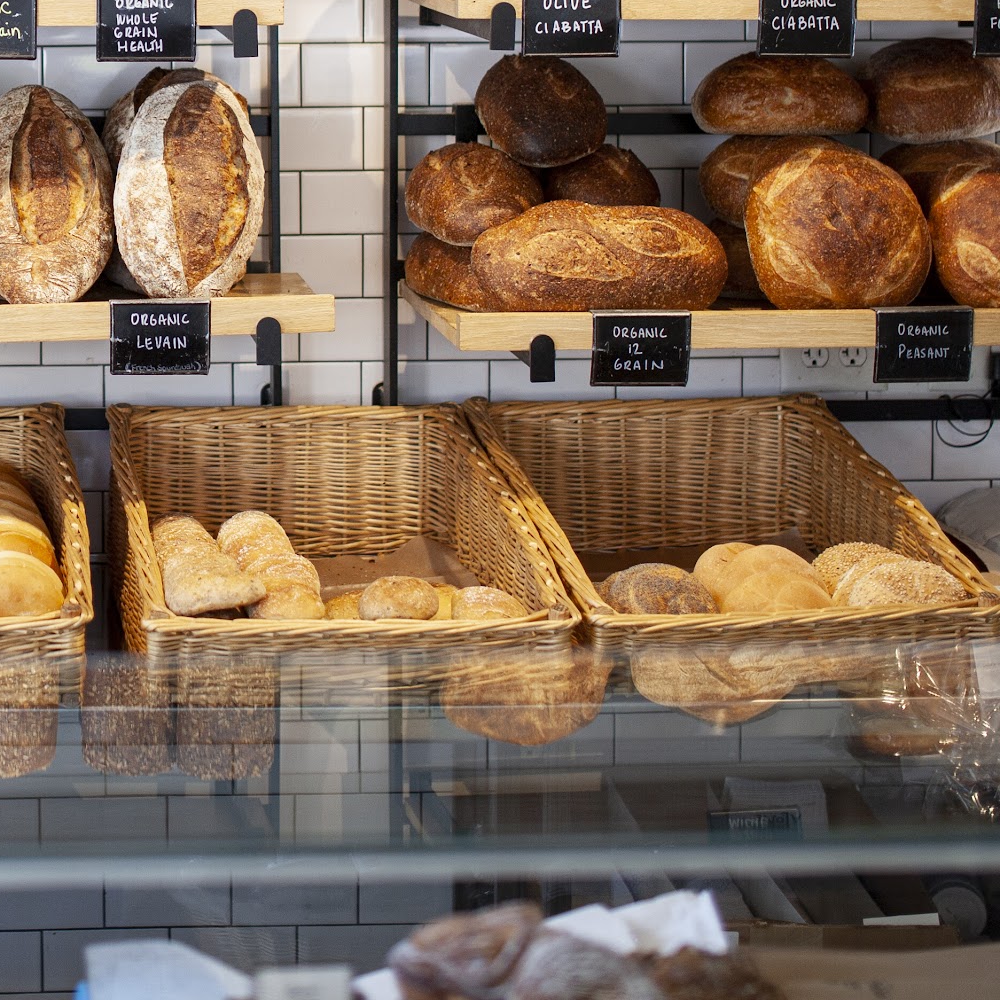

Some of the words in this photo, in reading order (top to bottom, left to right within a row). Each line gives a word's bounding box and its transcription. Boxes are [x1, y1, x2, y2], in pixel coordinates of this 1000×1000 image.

[116, 12, 159, 26] WHOLE
[771, 15, 840, 31] CIABATTA
[113, 26, 158, 38] GRAIN
[535, 19, 603, 35] CIABATTA
[117, 39, 163, 53] HEALTH
[130, 312, 190, 326] ORGANIC
[612, 325, 668, 339] ORGANIC
[897, 323, 949, 337] ORGANIC
[136, 335, 187, 350] LEVAIN
[628, 342, 643, 355] 12
[898, 343, 950, 359] PEASANT
[613, 358, 664, 371] GRAIN
